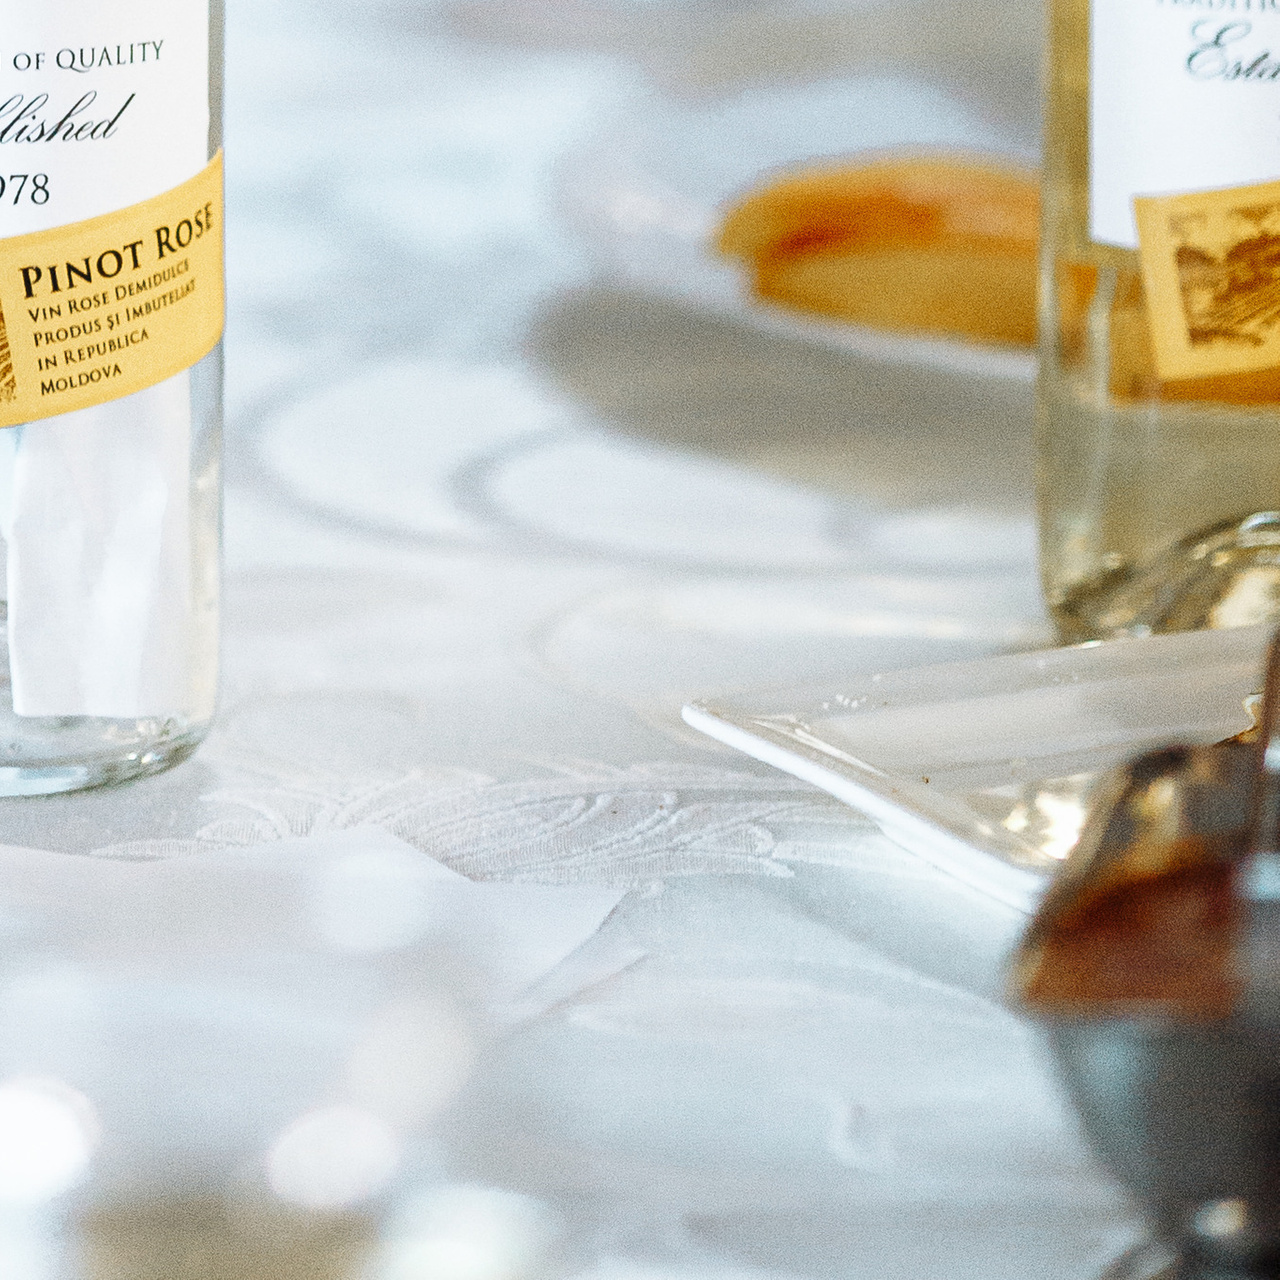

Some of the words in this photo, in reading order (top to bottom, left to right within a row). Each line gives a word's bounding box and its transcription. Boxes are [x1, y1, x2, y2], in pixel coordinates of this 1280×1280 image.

[12, 52, 46, 71] OF
[55, 40, 164, 73] QUALITY
[18, 240, 144, 300] PINOT
[28, 305, 62, 323] VIN
[67, 291, 110, 315] ROSE
[33, 318, 102, 348] PRODUS
[37, 355, 58, 372] IN
[63, 328, 149, 365] REPUBLICA
[40, 363, 122, 396] MOLDOVA
